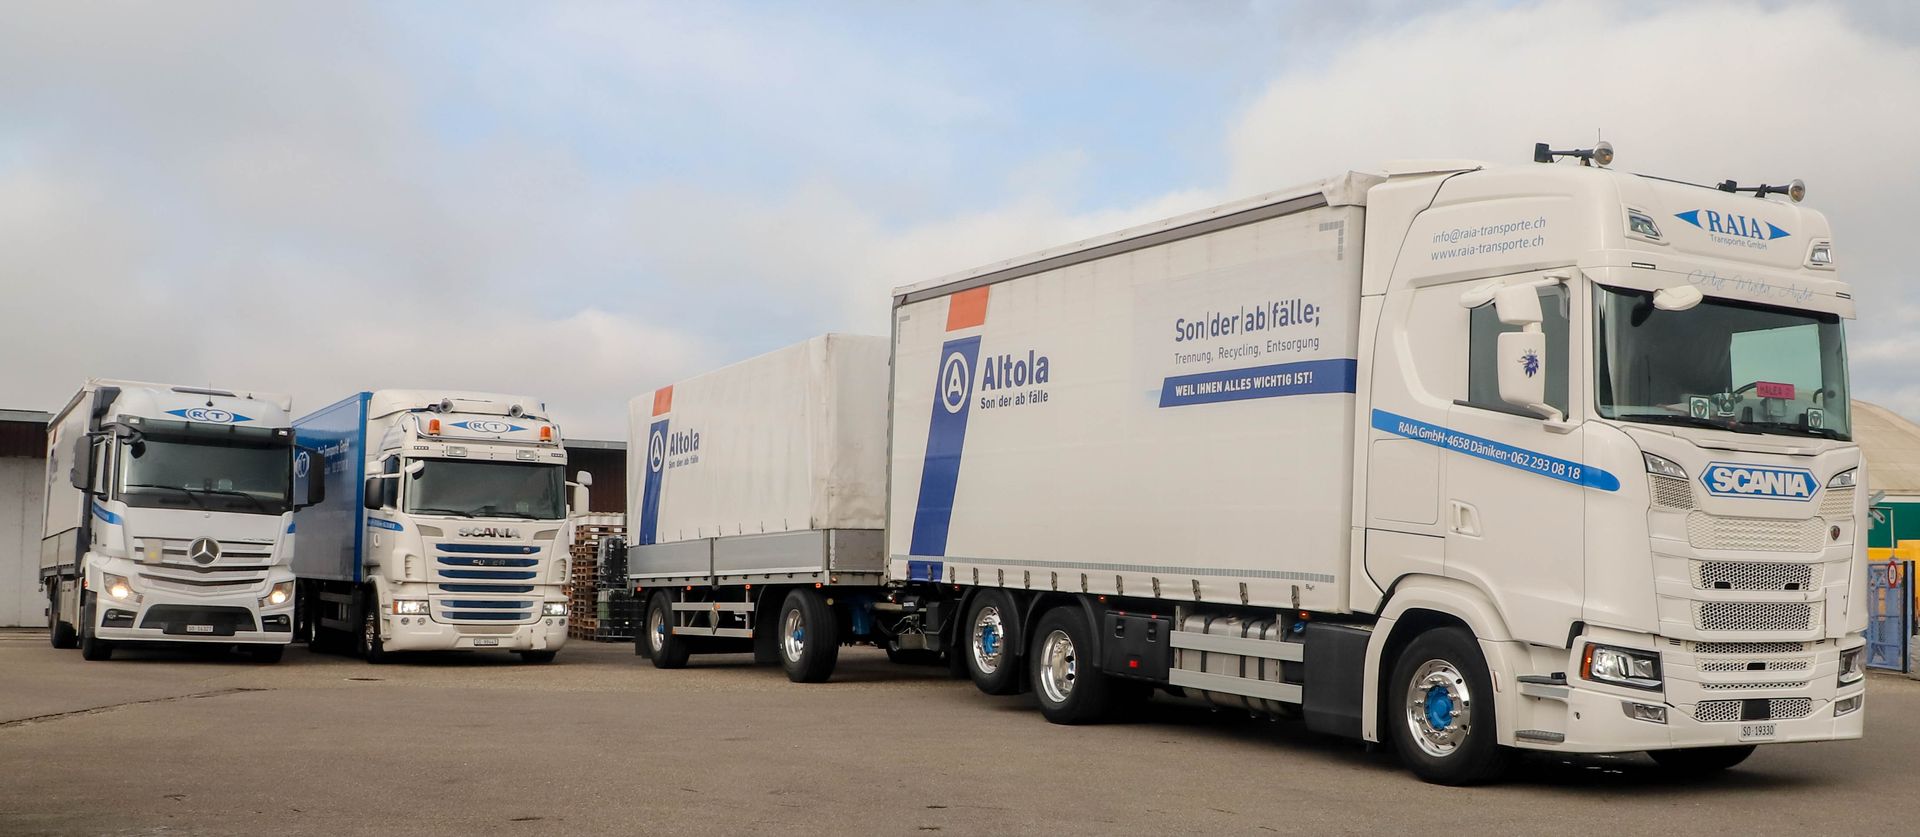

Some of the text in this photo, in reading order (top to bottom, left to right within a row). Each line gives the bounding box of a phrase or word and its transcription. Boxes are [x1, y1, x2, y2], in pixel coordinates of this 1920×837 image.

[1432, 217, 1546, 244] info@raia-transporte.ch
[1705, 210, 1765, 240] RAIA
[1430, 235, 1545, 261] www.raia-transporte.ch
[1711, 234, 1768, 250] Transporte GmbH
[1175, 336, 1320, 365] Trennung, Recycling, Entsorgung
[981, 349, 1049, 391] Altola
[1175, 371, 1314, 397] WEIL IHNEN ALLES WICHTIG IST!
[669, 428, 699, 456] Altola
[1398, 422, 1419, 435] RAIA
[1530, 455, 1550, 472] 293
[1551, 462, 1565, 475] 08
[1568, 465, 1580, 480] 18
[1712, 467, 1810, 497] SCANIA
[459, 528, 521, 538] SCANIA
[1755, 725, 1774, 736] 19330
